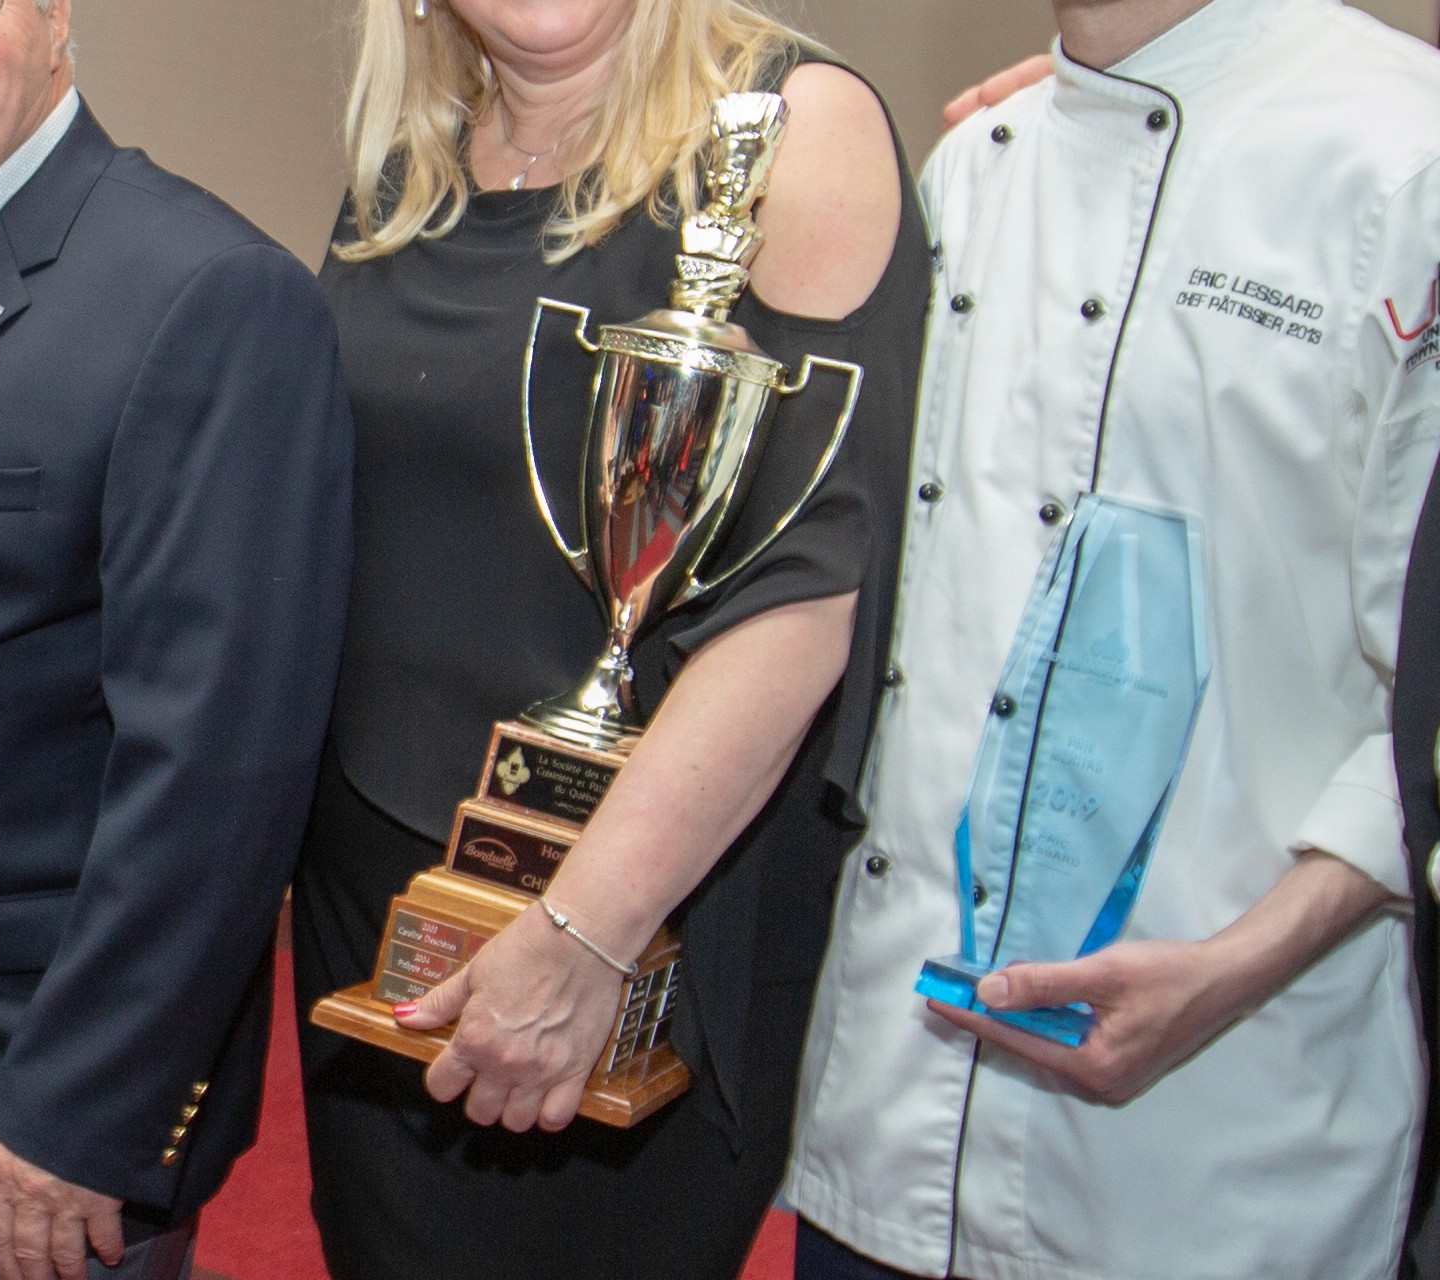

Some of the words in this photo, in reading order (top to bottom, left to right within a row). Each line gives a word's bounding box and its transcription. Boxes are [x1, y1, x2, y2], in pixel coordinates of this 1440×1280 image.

[1176, 291, 1208, 308] CHEF
[1188, 266, 1228, 290] ÉRIC
[1231, 276, 1325, 321] LESSARD
[536, 767, 573, 785] Cuisiniers
[576, 780, 586, 789] et
[539, 755, 549, 767] La
[584, 769, 600, 780] des
[554, 785, 566, 795] du
[1029, 780, 1103, 822] 2019
[464, 844, 517, 868] Bonduelle
[398, 926, 423, 941] Caroline
